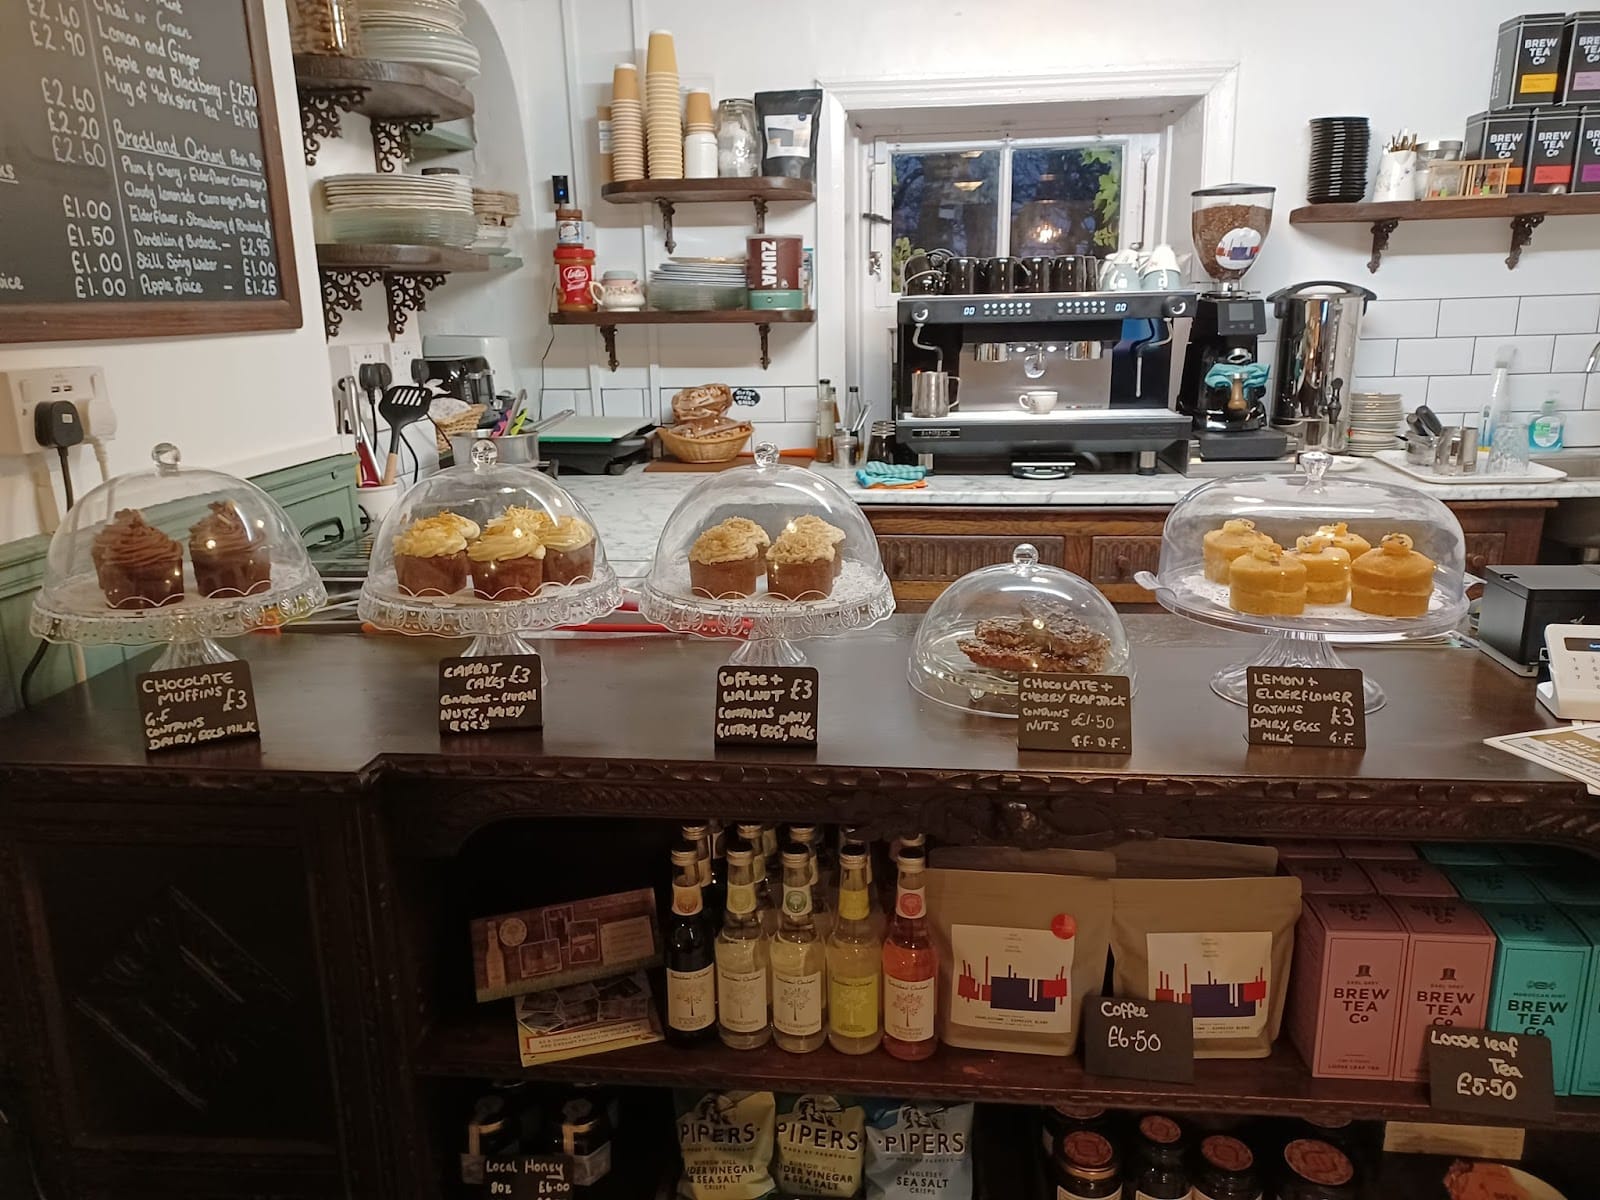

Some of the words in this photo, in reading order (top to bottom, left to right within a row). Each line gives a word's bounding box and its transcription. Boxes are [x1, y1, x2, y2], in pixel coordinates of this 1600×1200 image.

[30, 20, 85, 56] £2.90
[97, 15, 141, 48] Lemon
[144, 37, 166, 58] and
[168, 38, 200, 76] Ginger
[1525, 37, 1559, 49] BREW
[1529, 47, 1551, 57] TEA
[103, 45, 140, 74] Apple
[146, 64, 166, 83] and
[1532, 56, 1546, 65] Co
[41, 77, 96, 113] £2.60
[105, 72, 135, 107] Mug
[136, 80, 147, 103] of
[199, 97, 220, 122] Tea
[47, 107, 100, 140] £2.20
[112, 118, 181, 157] Breckland
[185, 136, 226, 166] Orchard
[1490, 132, 1524, 144] BREW
[1538, 131, 1572, 143] BREW
[1542, 139, 1565, 150] TEA
[52, 135, 106, 168] £2.60
[1494, 142, 1517, 151] TEA
[1546, 147, 1559, 158] Co
[1498, 150, 1511, 159] Co
[62, 194, 112, 221] £1.00
[67, 223, 115, 247] £1.50
[240, 236, 271, 257] £2.95
[71, 250, 122, 274] £1.00
[242, 258, 277, 277] £1.00
[760, 240, 777, 288] ZUMA
[75, 275, 126, 299] £1.00
[140, 273, 173, 295] Apple
[174, 276, 204, 295] Juice
[244, 279, 277, 296] £1.25
[444, 662, 503, 678] CARROT
[508, 665, 531, 683] £3
[1254, 673, 1304, 686] LEMON
[142, 672, 234, 693] CHOCOLATE
[466, 676, 507, 690] CAKES
[723, 689, 785, 702] WALNUT
[790, 678, 813, 701] £3
[1023, 678, 1098, 692] CHOCOLATE
[158, 686, 222, 706] MUFFINS
[222, 688, 248, 712] £3
[1020, 692, 1066, 703] CHERRY
[1256, 688, 1353, 707] ELDERFLOWER
[487, 705, 525, 718] DAIRY
[718, 707, 775, 720] CONTAINS
[1022, 707, 1070, 718] CONTAINS
[1071, 712, 1115, 729] £1.50
[1252, 703, 1303, 714] CONTAINS
[1330, 706, 1355, 727] £3
[146, 717, 205, 738] CONTAINS
[227, 722, 256, 734] MILK
[1026, 719, 1060, 732] NUTS
[1250, 718, 1290, 732] DAIRY,
[1293, 719, 1321, 732] EGGS
[1262, 732, 1294, 744] MILK
[1333, 987, 1390, 1000] BREW
[1416, 991, 1475, 1004] BREW
[1101, 1001, 1149, 1018] Coffee
[1342, 1000, 1378, 1012] TEA
[1425, 1004, 1463, 1016] TEA
[1507, 999, 1568, 1013] BREW
[1349, 1013, 1369, 1024] Co
[1432, 1017, 1453, 1027] Co
[1517, 1013, 1555, 1026] TEA
[1524, 1026, 1545, 1036] Co
[1431, 1031, 1480, 1048] Loose
[1483, 1037, 1519, 1060] leaf
[1488, 1058, 1523, 1078] Tea
[1456, 1072, 1517, 1100] £5.50
[681, 1123, 756, 1144] PIPERS
[777, 1122, 860, 1151] PIPERS
[885, 1131, 965, 1154] PIPERS
[486, 1160, 518, 1173] Local
[524, 1158, 565, 1181] Honey
[710, 1165, 755, 1175] VINEGAR
[806, 1169, 853, 1184] VINEGAR
[697, 1175, 714, 1184] SEA
[717, 1175, 741, 1184] SALT
[793, 1175, 811, 1185] SEA
[814, 1180, 838, 1190] SALT
[896, 1177, 920, 1186] SEA
[921, 1178, 949, 1189] SALT
